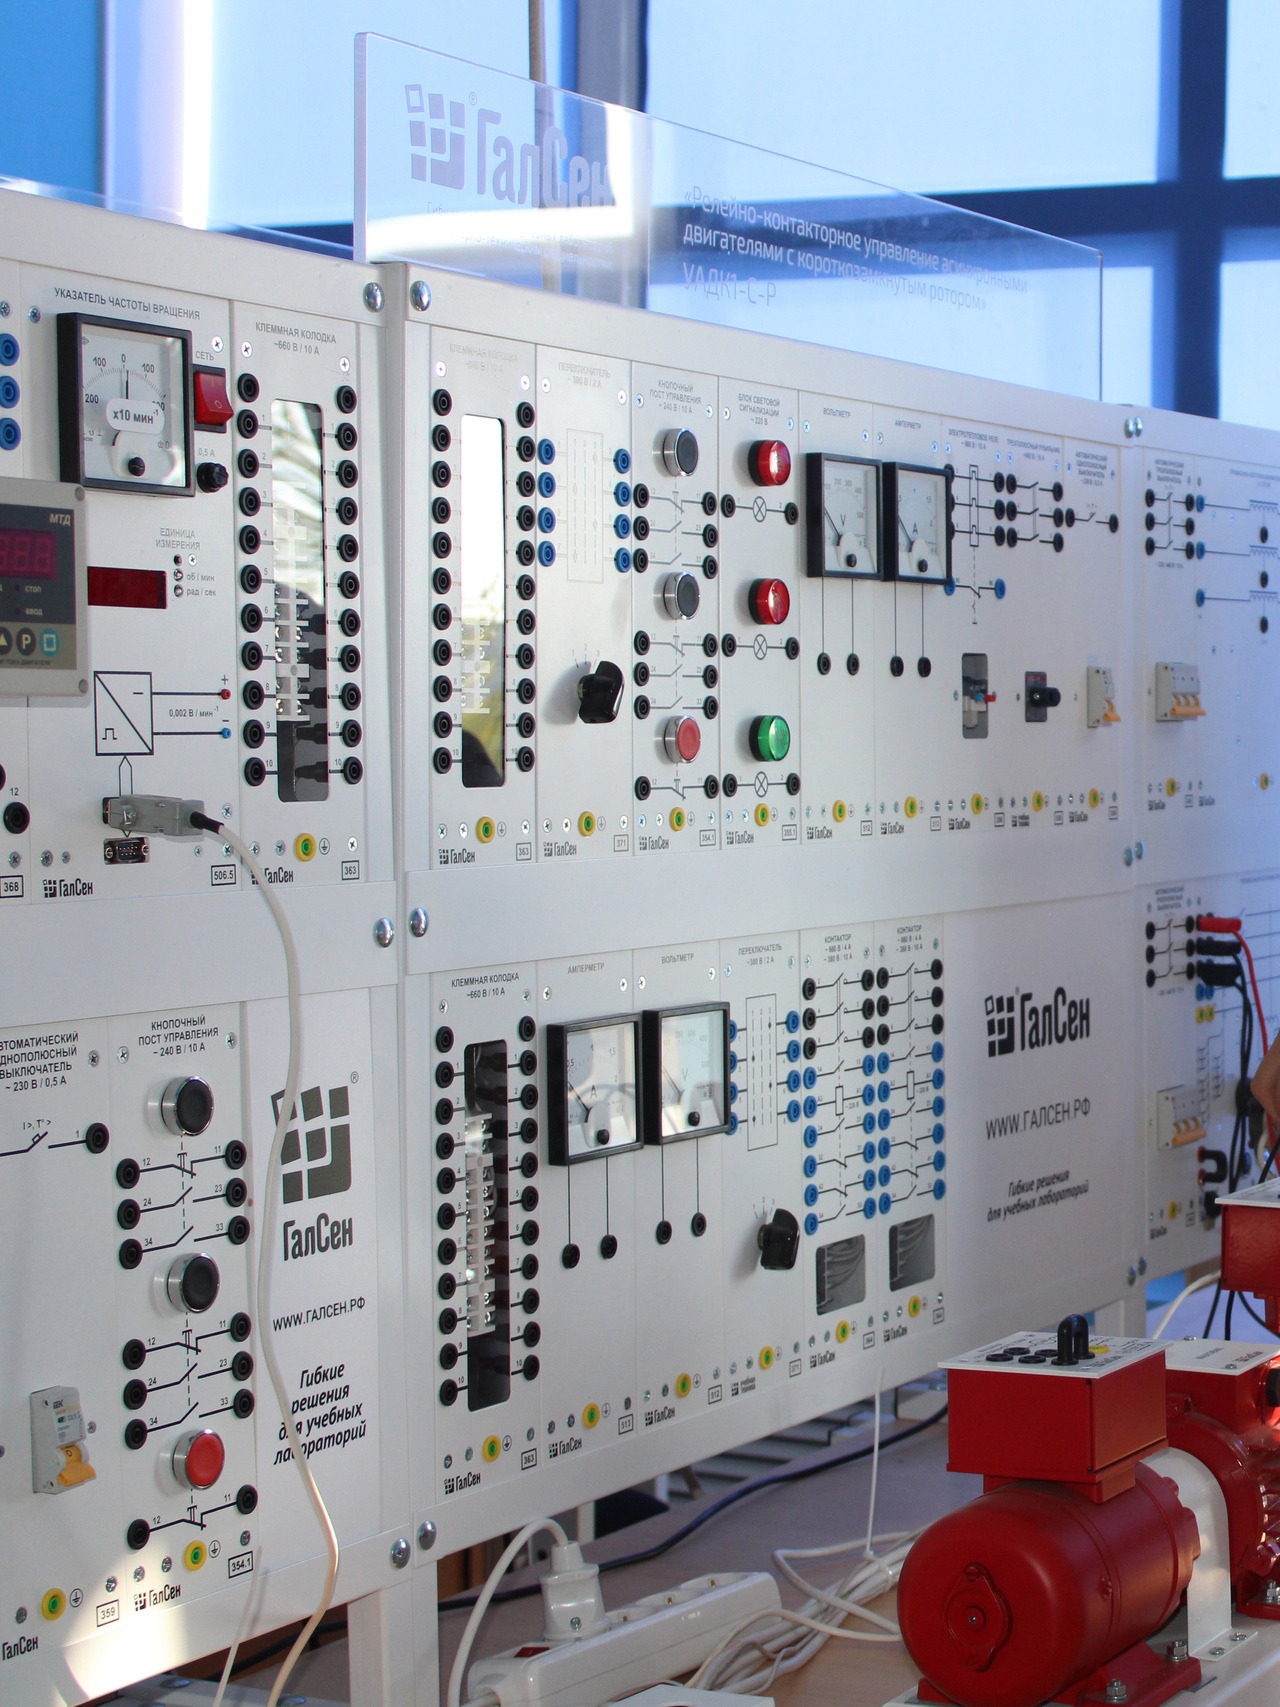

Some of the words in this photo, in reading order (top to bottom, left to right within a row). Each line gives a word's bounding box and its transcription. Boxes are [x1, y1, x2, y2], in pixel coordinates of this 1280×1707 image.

[477, 108, 616, 208] ГалСен
[684, 186, 862, 252] «Релейно-контакторное
[864, 235, 939, 271] управление
[941, 258, 1028, 294] асинхронными
[683, 224, 784, 264] двигателями
[786, 248, 794, 266] с
[797, 250, 928, 299] короткозамкнутым
[929, 281, 987, 312] ротором»
[54, 287, 107, 305] УКАЗАТЕЛЬ
[108, 296, 151, 313] ЧАСТОТЫ
[153, 303, 201, 320] ВРАЩЕНИЯ
[255, 321, 299, 338] КЛЕММНАЯ
[300, 328, 337, 345] КОЛОДКА
[195, 350, 215, 361] СЕТЬ
[304, 344, 313, 355] 10
[93, 357, 107, 367] 100
[121, 353, 127, 363] 0
[141, 362, 155, 374] 100
[558, 361, 612, 379] ПЕРЕКЛЮЧАТЕЛЬ
[658, 379, 694, 393] КНОПОЧНЫЙ
[85, 394, 99, 404] 200
[650, 389, 665, 399] ПОСТ
[666, 392, 702, 405] УПРАВЛЕНИЯ
[738, 393, 752, 402] БЛОК
[752, 395, 781, 408] СВЕТОВОЙ
[739, 403, 780, 418] СИГНАЛИЗАЦИИ
[823, 407, 851, 419] ВОЛЬТМЕТР
[894, 419, 922, 430] АМПЕРМЕТР
[50, 513, 72, 526] МТД
[840, 514, 846, 527] V
[160, 527, 196, 539] ЕДИНИЦА
[155, 539, 201, 550] ИЗМЕРЕНИЯ
[186, 588, 200, 597] рад
[204, 589, 217, 597] сек
[169, 709, 188, 718] 0,002
[10, 787, 19, 796] 12
[886, 822, 905, 834] ГалСен
[954, 817, 971, 830] ГалСен
[734, 830, 754, 845] ГалСен
[814, 826, 833, 840] ГалСен
[553, 842, 577, 857] ГалСен
[647, 836, 670, 851] ГалСен
[450, 850, 476, 865] ГалСен
[213, 870, 234, 880] 506.5
[264, 867, 294, 884] ГалСен
[344, 866, 357, 875] 363
[3, 881, 20, 892] 368
[59, 878, 94, 897] ГалСен
[824, 933, 852, 944] КОНТАКТОР
[738, 943, 782, 956] ПЕРЕКЛЮЧАТЕЛЬ
[661, 952, 695, 965] ВОЛЬТМЕТР
[567, 962, 605, 975] АМПЕРМЕТР
[451, 974, 489, 988] КЛЕММНАЯ
[489, 972, 520, 985] КОЛОДКА
[492, 988, 500, 997] 10
[151, 1014, 206, 1031] КНОПОЧНЫЙ
[1020, 986, 1091, 1051] ГалСен
[0, 1031, 79, 1051] ВТОМАТИЧЕСКИЙ
[138, 1034, 161, 1047] ПОСТ
[163, 1027, 219, 1045] УПРАВЛЕНИЯ
[0, 1045, 78, 1067] ДНОПОЛЮСНЫЙ
[160, 1046, 174, 1057] 240
[176, 1045, 182, 1055] В
[188, 1044, 198, 1053] 10
[0, 1062, 73, 1080] ВЫКЛЮЧАТЕЛЬ
[13, 1080, 29, 1092] 230
[31, 1079, 38, 1090] В
[45, 1077, 58, 1088] 0,5
[986, 1097, 1091, 1140] WWW.ГАЛСЕН.РФ
[214, 1145, 222, 1154] 11
[142, 1157, 151, 1166] 12
[214, 1184, 223, 1193] 23
[1008, 1178, 1035, 1197] Гибкие
[1036, 1170, 1070, 1192] решения
[143, 1198, 152, 1207] 24
[986, 1207, 1001, 1222] для
[1002, 1197, 1036, 1221] учебных
[1037, 1180, 1090, 1208] лабораторий
[215, 1222, 224, 1231] 33
[144, 1238, 153, 1247] 34
[283, 1212, 354, 1261] ГалСен
[272, 1296, 366, 1332] WWW.ГАЛСЕН.РФ
[219, 1320, 227, 1328] 11
[889, 1325, 908, 1342] ГалСен
[147, 1337, 156, 1346] 12
[219, 1358, 228, 1367] 23
[817, 1351, 836, 1368] ГалСен
[148, 1377, 157, 1386] 24
[300, 1363, 345, 1389] Гибкие
[291, 1384, 350, 1415] решения
[709, 1389, 721, 1400] 512
[220, 1397, 229, 1406] 33
[149, 1417, 158, 1425] 34
[278, 1421, 303, 1441] дя
[306, 1402, 363, 1437] учебных
[653, 1407, 676, 1425] ГалСен
[620, 1419, 631, 1430] 513
[273, 1419, 367, 1466] лаораторий
[558, 1437, 582, 1455] ГалСен
[523, 1454, 535, 1464] 363
[455, 1471, 481, 1492] ГалСен
[224, 1494, 231, 1502] 11
[152, 1516, 161, 1525] 12
[231, 1557, 251, 1571] 354.1
[149, 1583, 181, 1605] ГалСен
[100, 1607, 116, 1620] 359
[2, 1635, 39, 1661] ГалСен
